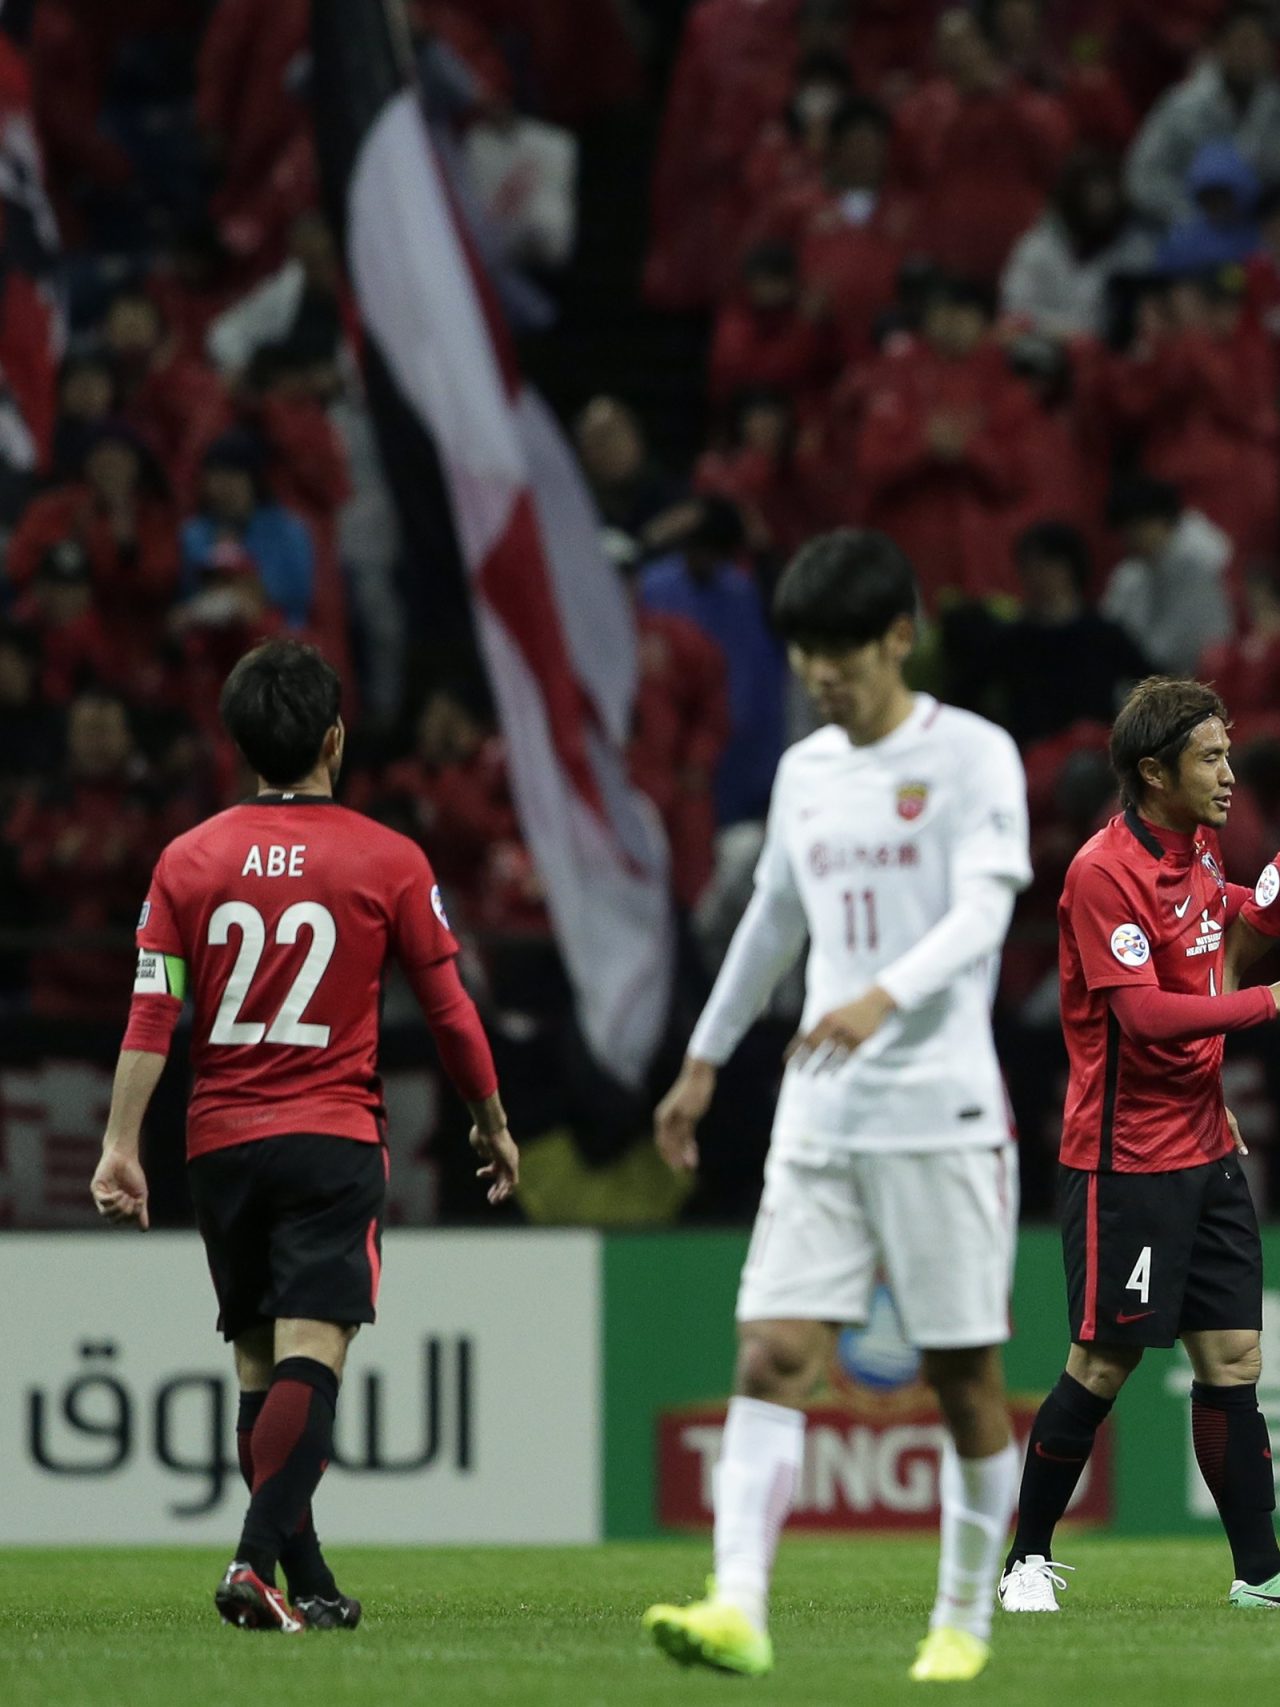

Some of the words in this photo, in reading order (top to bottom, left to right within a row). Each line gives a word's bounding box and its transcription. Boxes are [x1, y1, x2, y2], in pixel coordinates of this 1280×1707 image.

[242, 844, 307, 877] ABE
[842, 888, 879, 953] 11
[207, 900, 337, 1049] 22
[1125, 1246, 1152, 1304] 4
